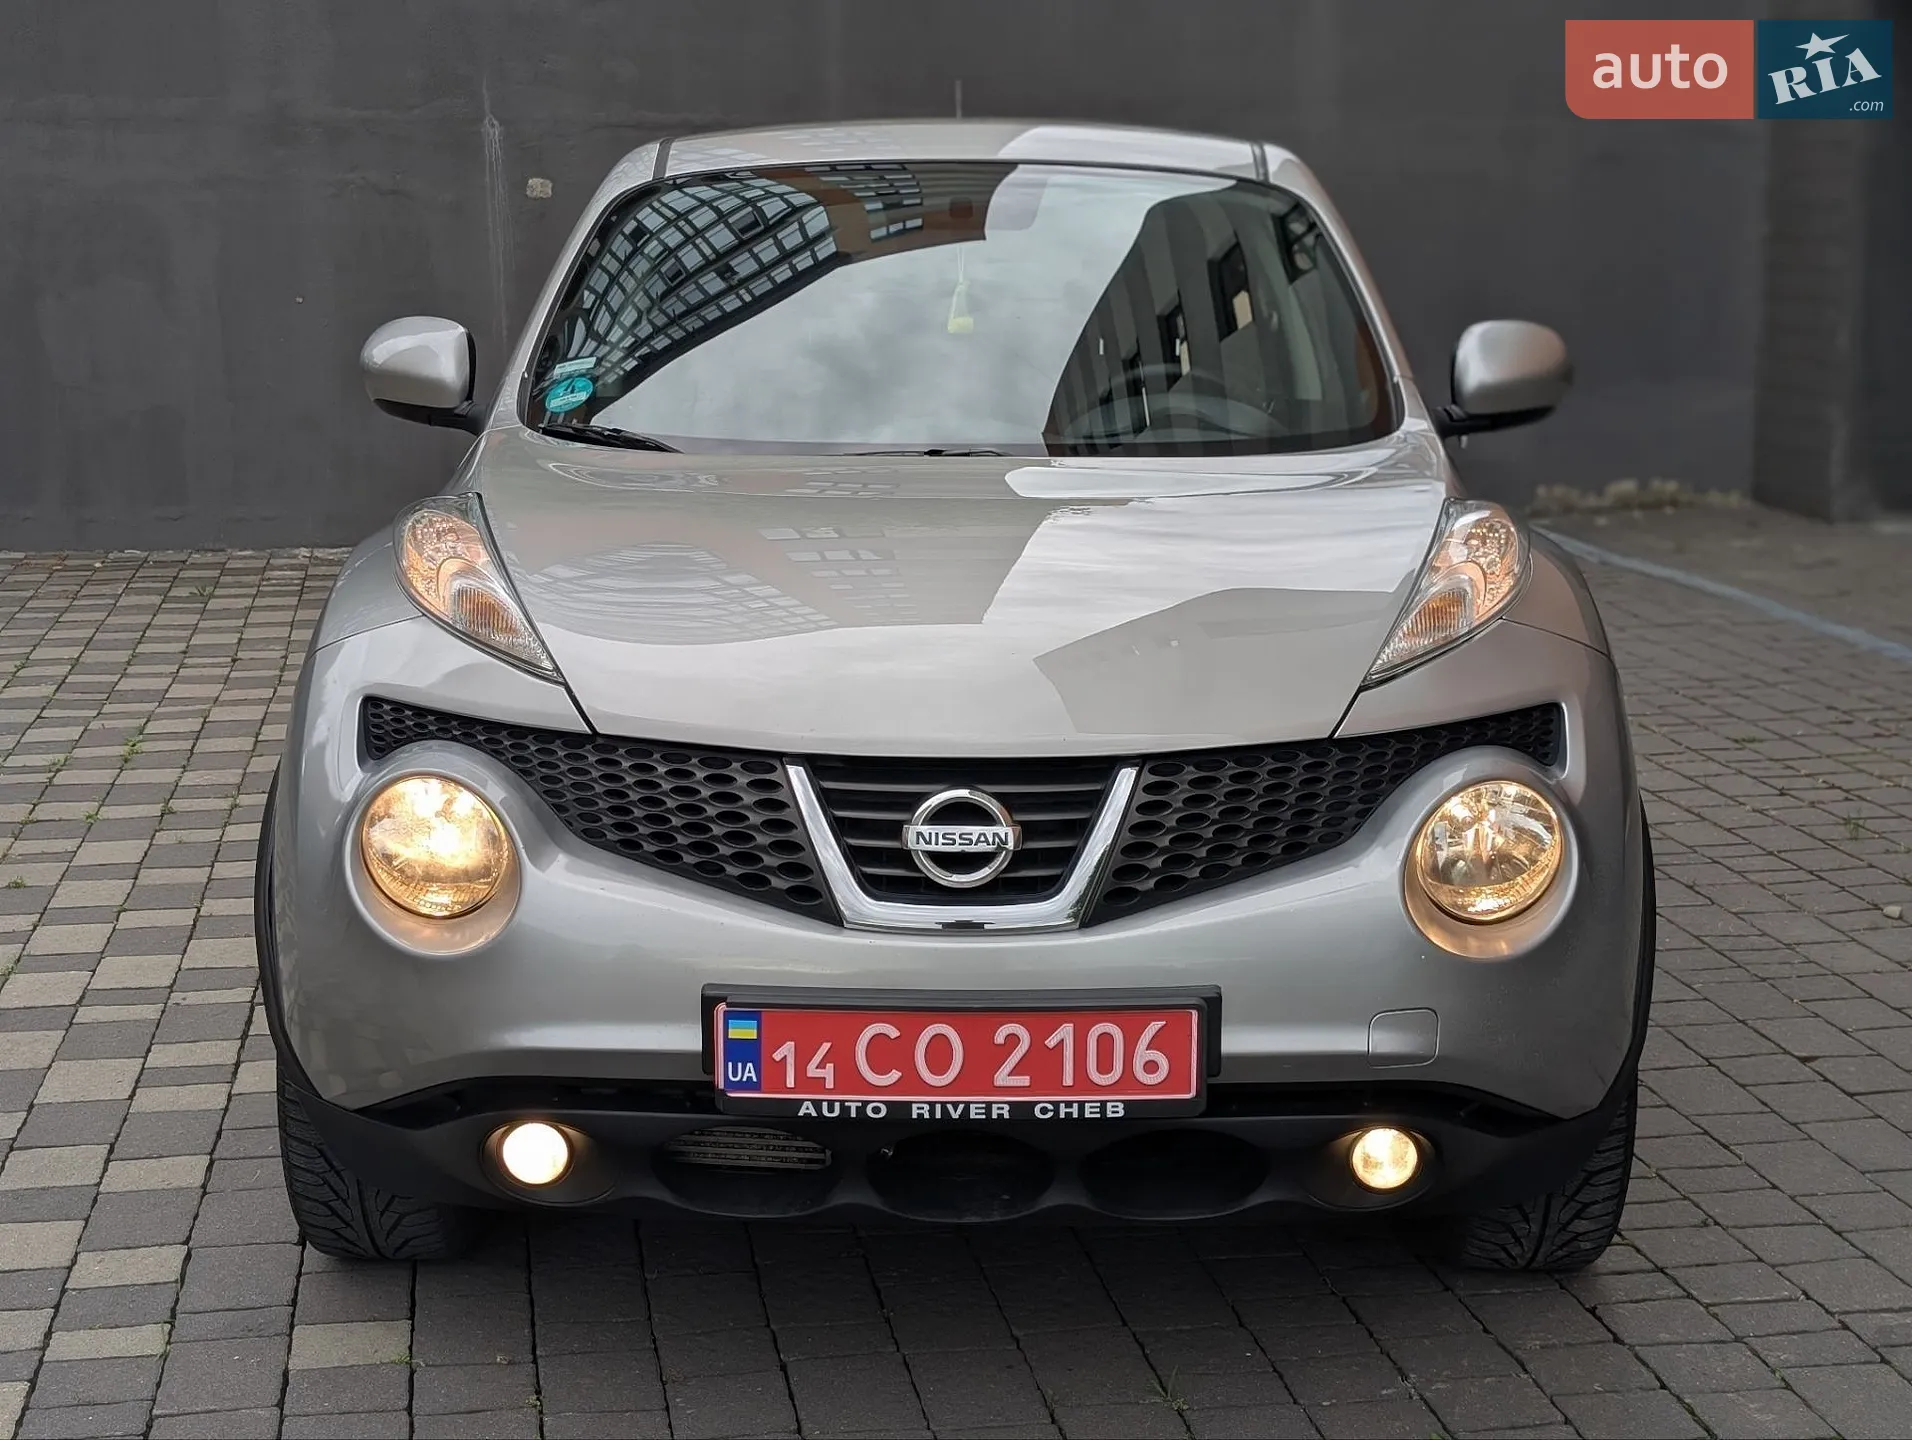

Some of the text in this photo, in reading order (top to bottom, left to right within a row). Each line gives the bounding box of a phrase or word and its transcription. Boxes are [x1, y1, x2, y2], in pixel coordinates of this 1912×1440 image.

[915, 831, 1009, 847] NISSAN
[771, 1020, 1171, 1090] 14 CO 2106
[727, 1061, 758, 1083] UA
[798, 1101, 1127, 1121] AUTO RIVER CHEB
